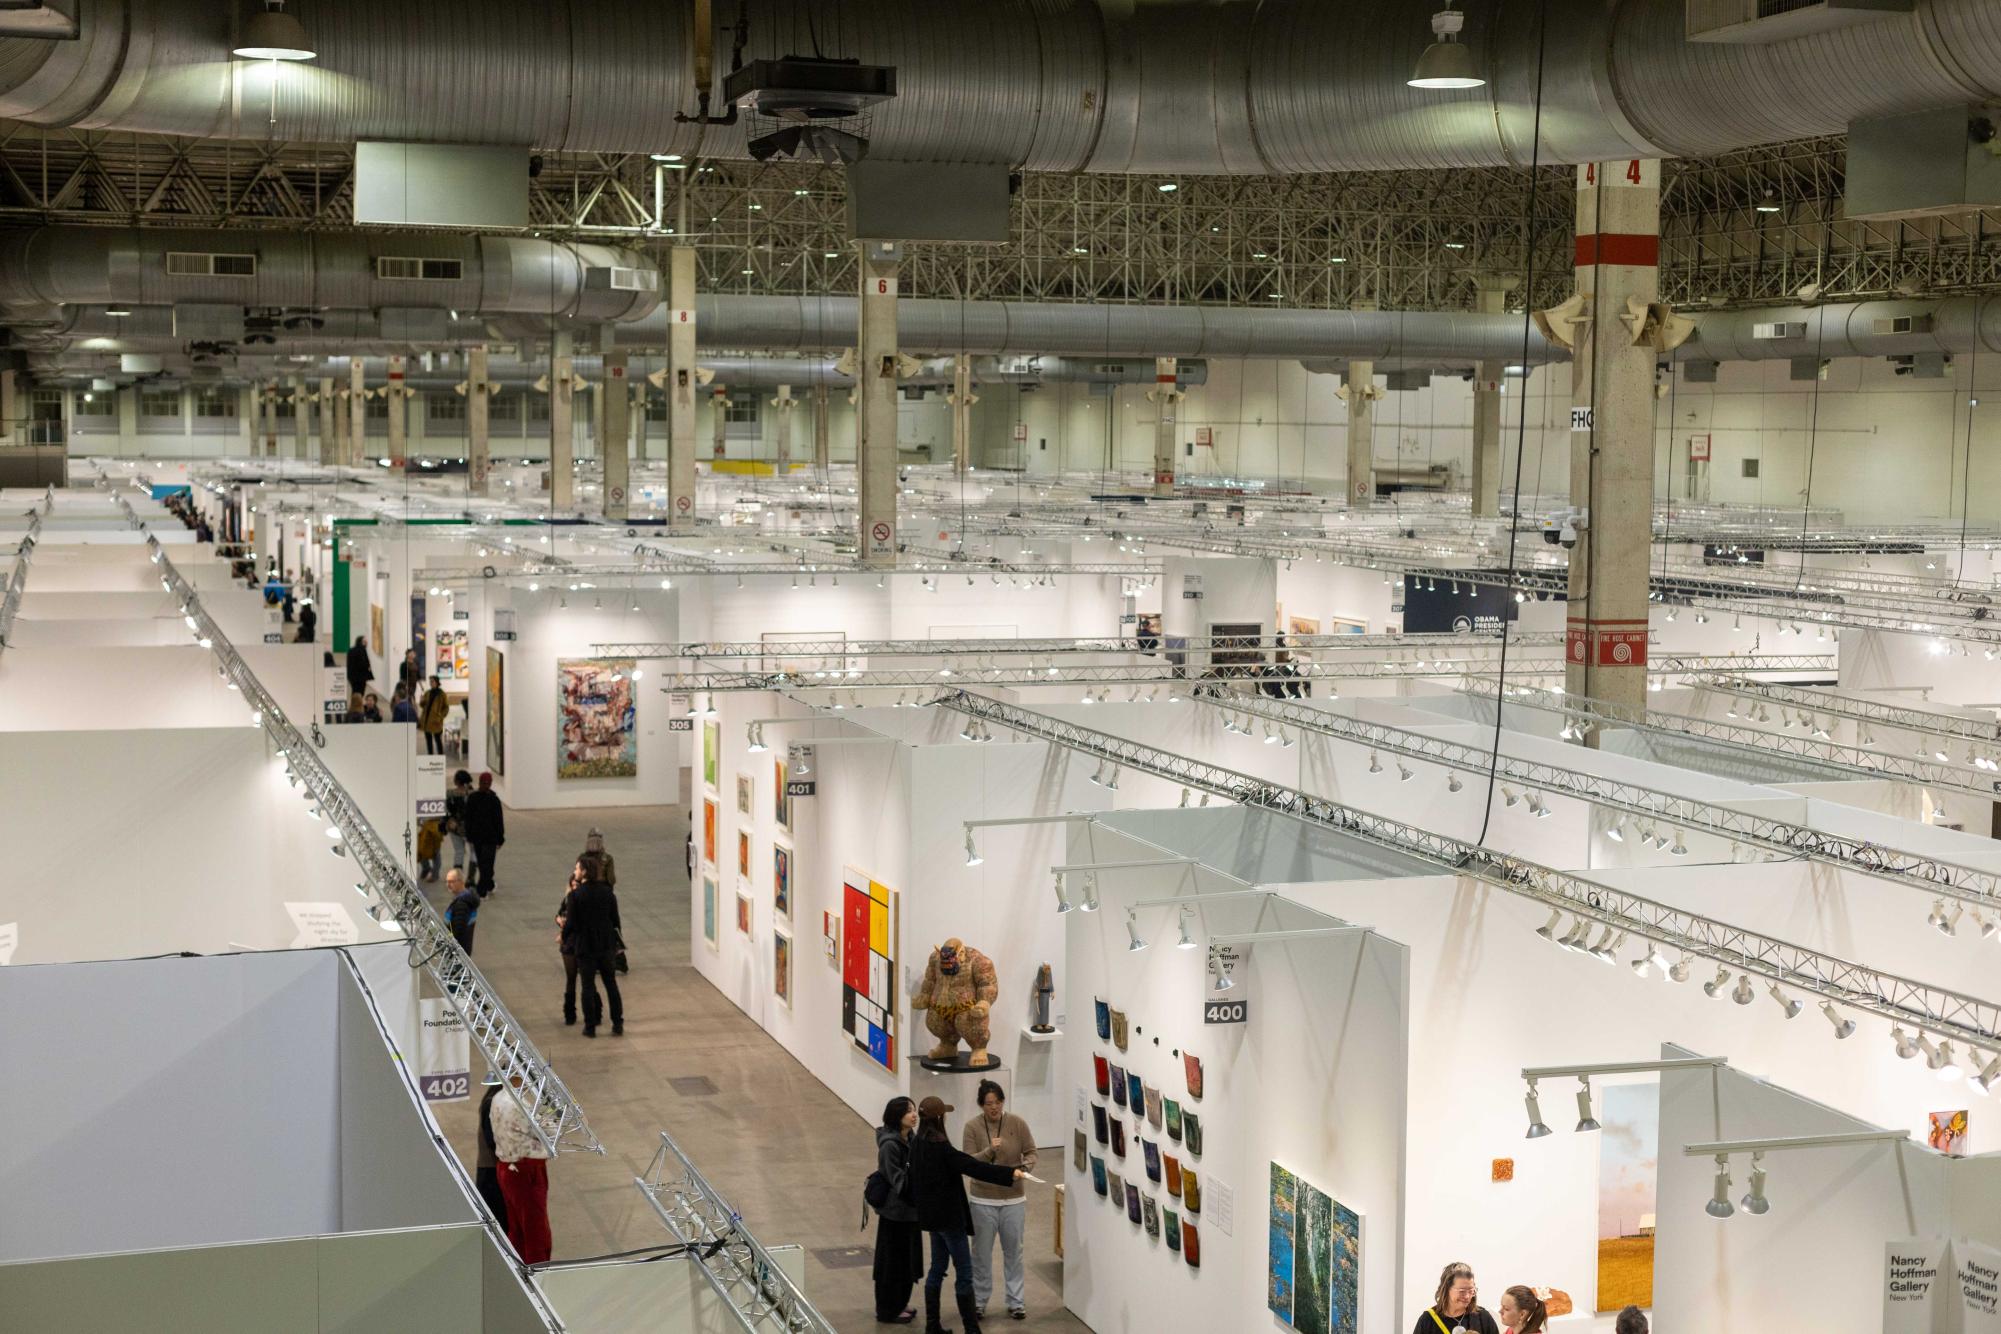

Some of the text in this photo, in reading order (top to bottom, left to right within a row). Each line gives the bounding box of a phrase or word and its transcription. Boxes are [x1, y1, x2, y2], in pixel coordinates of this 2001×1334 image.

[1586, 162, 1595, 185] 4
[1626, 159, 1641, 185] 4
[879, 279, 887, 294] 6
[680, 311, 687, 322] 8
[1600, 634, 1610, 642] FIRE
[1612, 634, 1624, 642] HOSE
[1626, 634, 1645, 642] CABINET
[327, 702, 346, 710] 403
[670, 721, 690, 729] 305
[788, 784, 810, 794] 401
[420, 801, 445, 813] 402
[1208, 961, 1234, 969] Gery
[1207, 1005, 1243, 1021] 400
[424, 1019, 462, 1028] Foundatio
[427, 1077, 468, 1097] 402
[1891, 1255, 1926, 1267] Nancy
[1890, 1268, 1937, 1279] Hoffman
[1967, 1260, 1999, 1281] Nancy
[1890, 1281, 1929, 1293] Gallery
[1958, 1270, 1998, 1292] Hoffman
[1909, 1293, 1923, 1301] York
[1963, 1286, 1997, 1307] Gallery
